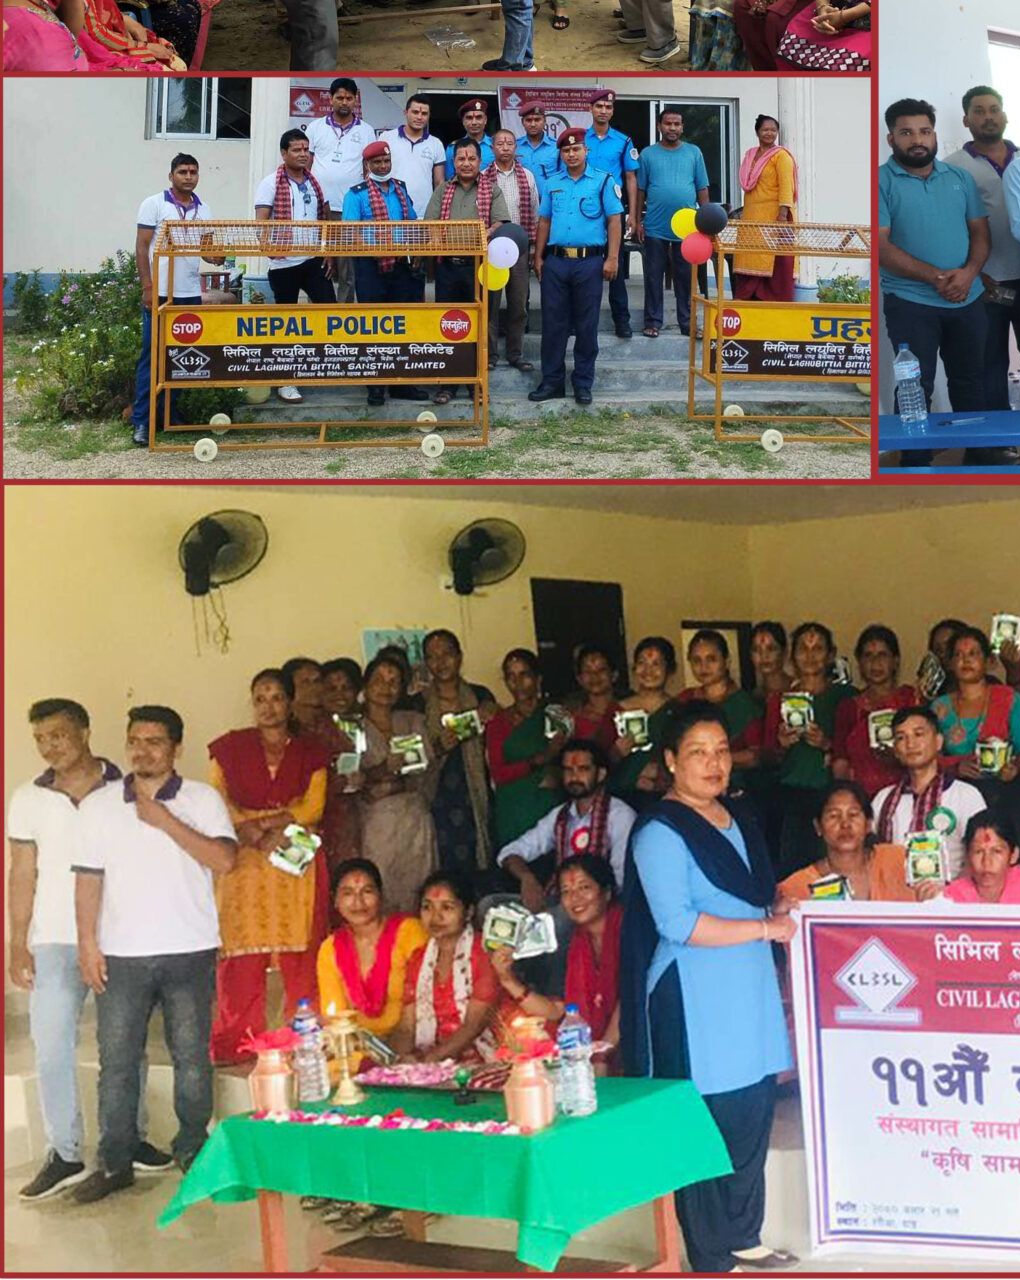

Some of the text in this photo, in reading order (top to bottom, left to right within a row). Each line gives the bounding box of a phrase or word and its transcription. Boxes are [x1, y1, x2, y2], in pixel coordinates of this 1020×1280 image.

[173, 323, 201, 334] STOP
[236, 315, 406, 336] NEPAL POLICE
[721, 317, 740, 329] TOP
[222, 344, 455, 358] सिभिल लघुवित्त वित्तीय संस्था लिमिटेड
[763, 341, 799, 353] सिभिल
[935, 935, 1001, 962] सिभिल
[936, 991, 983, 1011] CIVIL
[876, 1115, 960, 1137] संस्थागत
